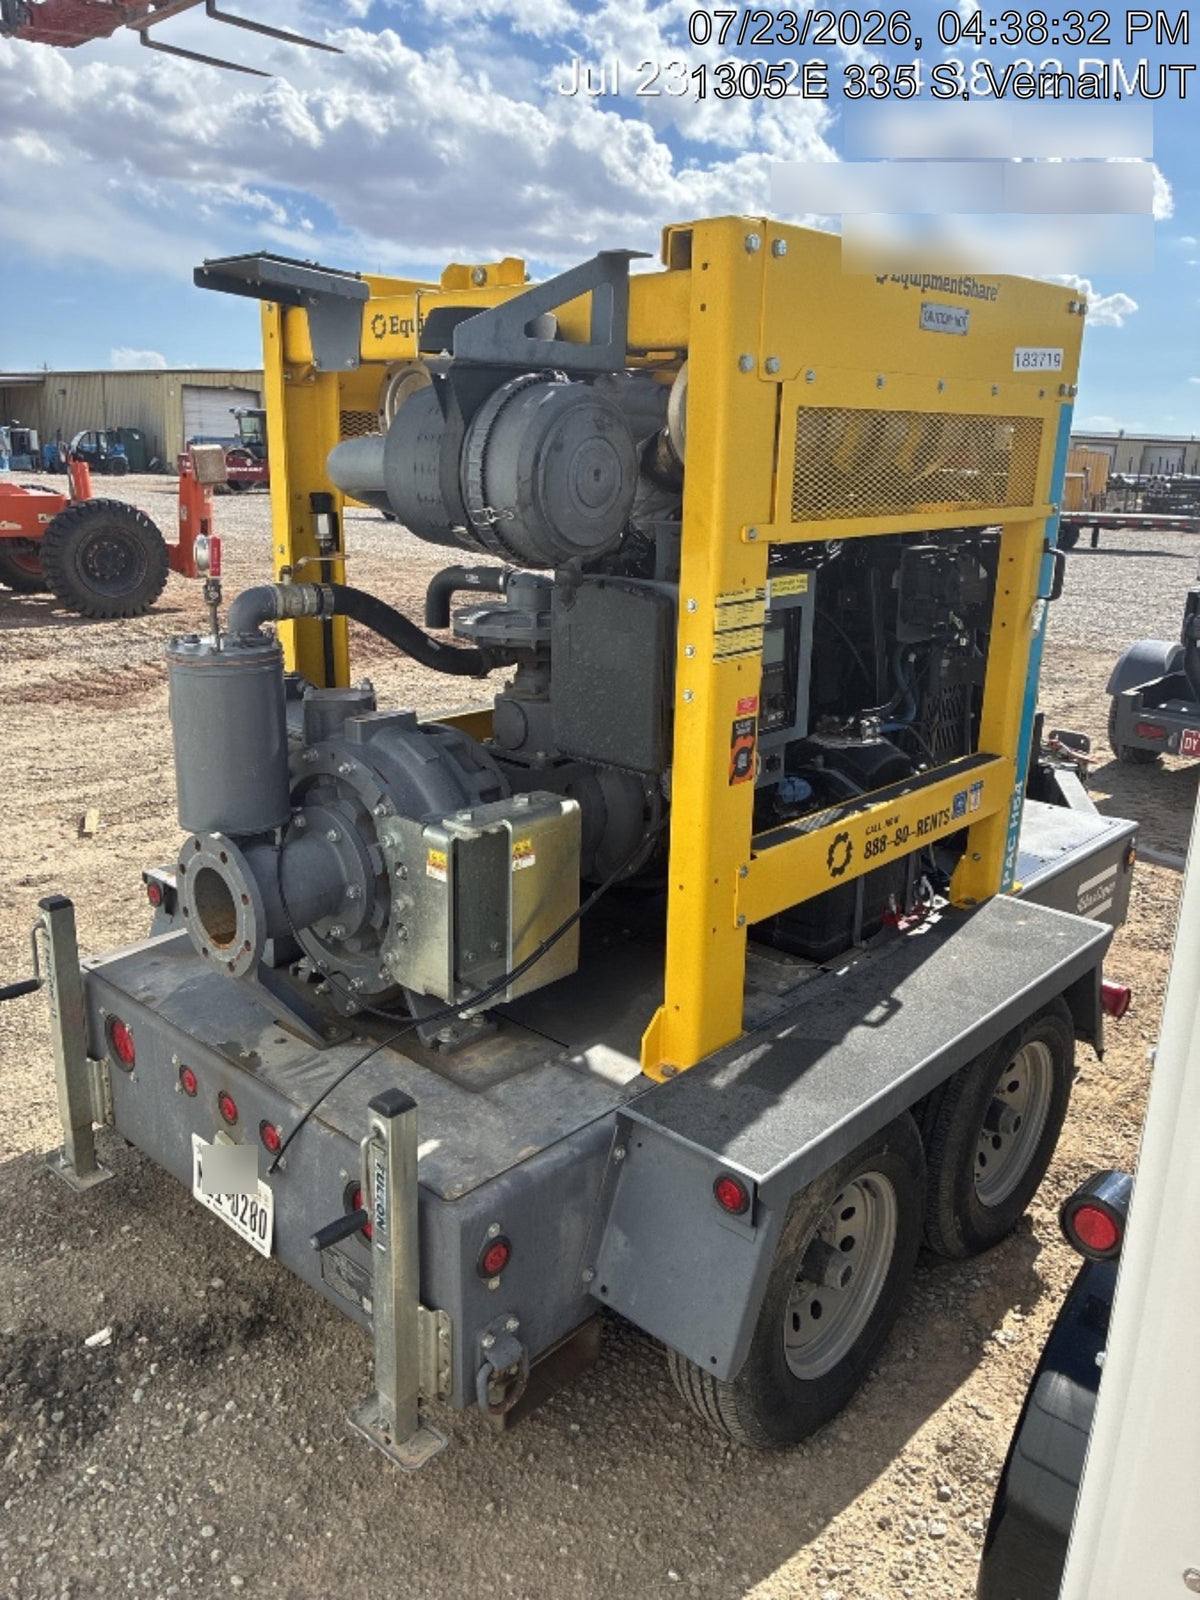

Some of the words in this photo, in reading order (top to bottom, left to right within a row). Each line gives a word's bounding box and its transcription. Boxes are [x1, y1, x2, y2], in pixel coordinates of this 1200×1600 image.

[1015, 352, 1062, 369] 183719
[865, 823, 882, 836] CALL
[885, 814, 899, 827] NOW
[1002, 835, 1015, 886] PAC
